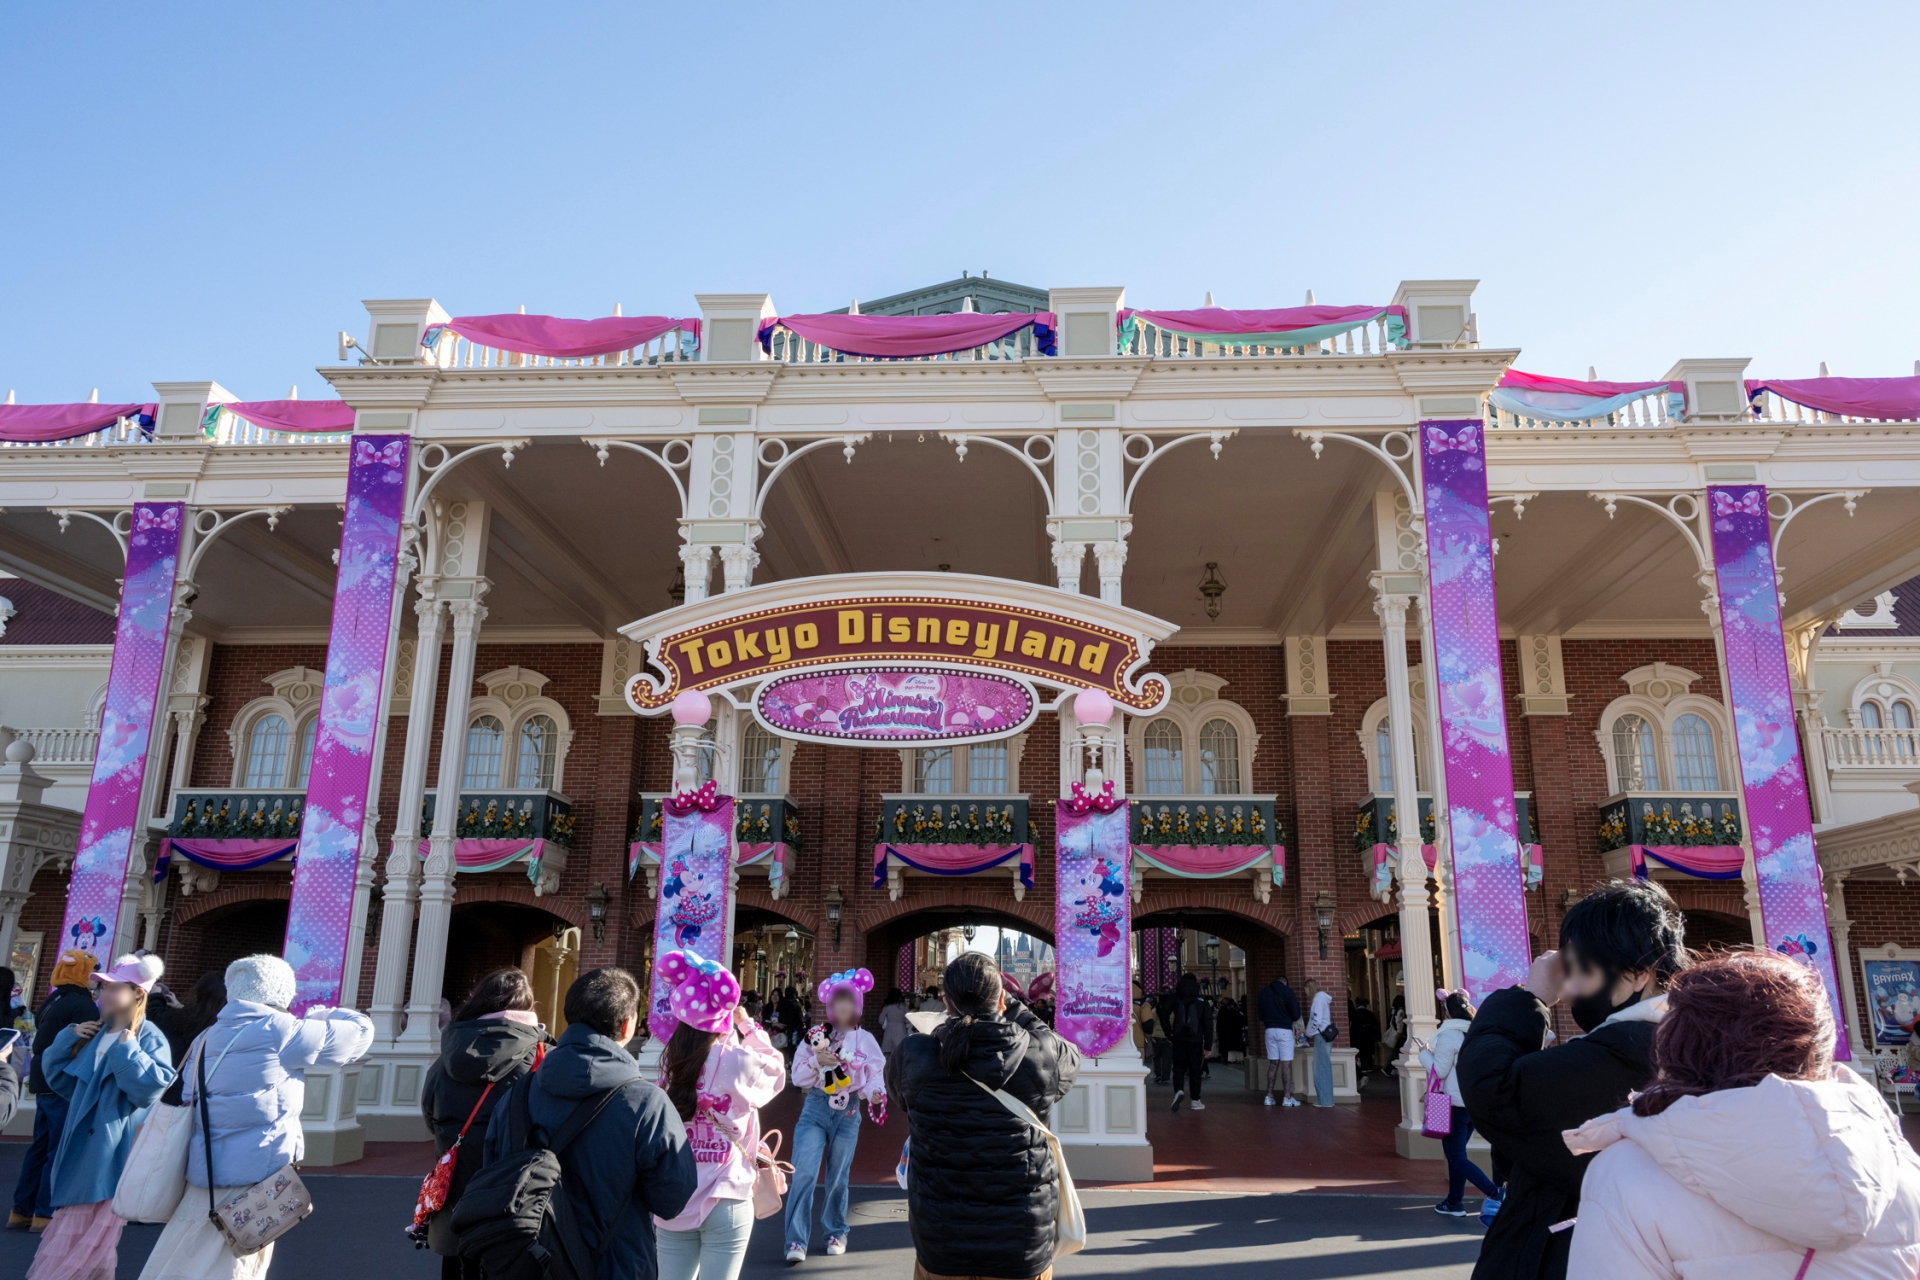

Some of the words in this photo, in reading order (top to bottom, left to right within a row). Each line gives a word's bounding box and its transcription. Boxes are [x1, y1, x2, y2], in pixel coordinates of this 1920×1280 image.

[679, 622, 819, 675] Tokyo
[838, 609, 1110, 675] Disneyland
[858, 687, 938, 715] Minnie's
[1872, 971, 1916, 986] BAYMAX
